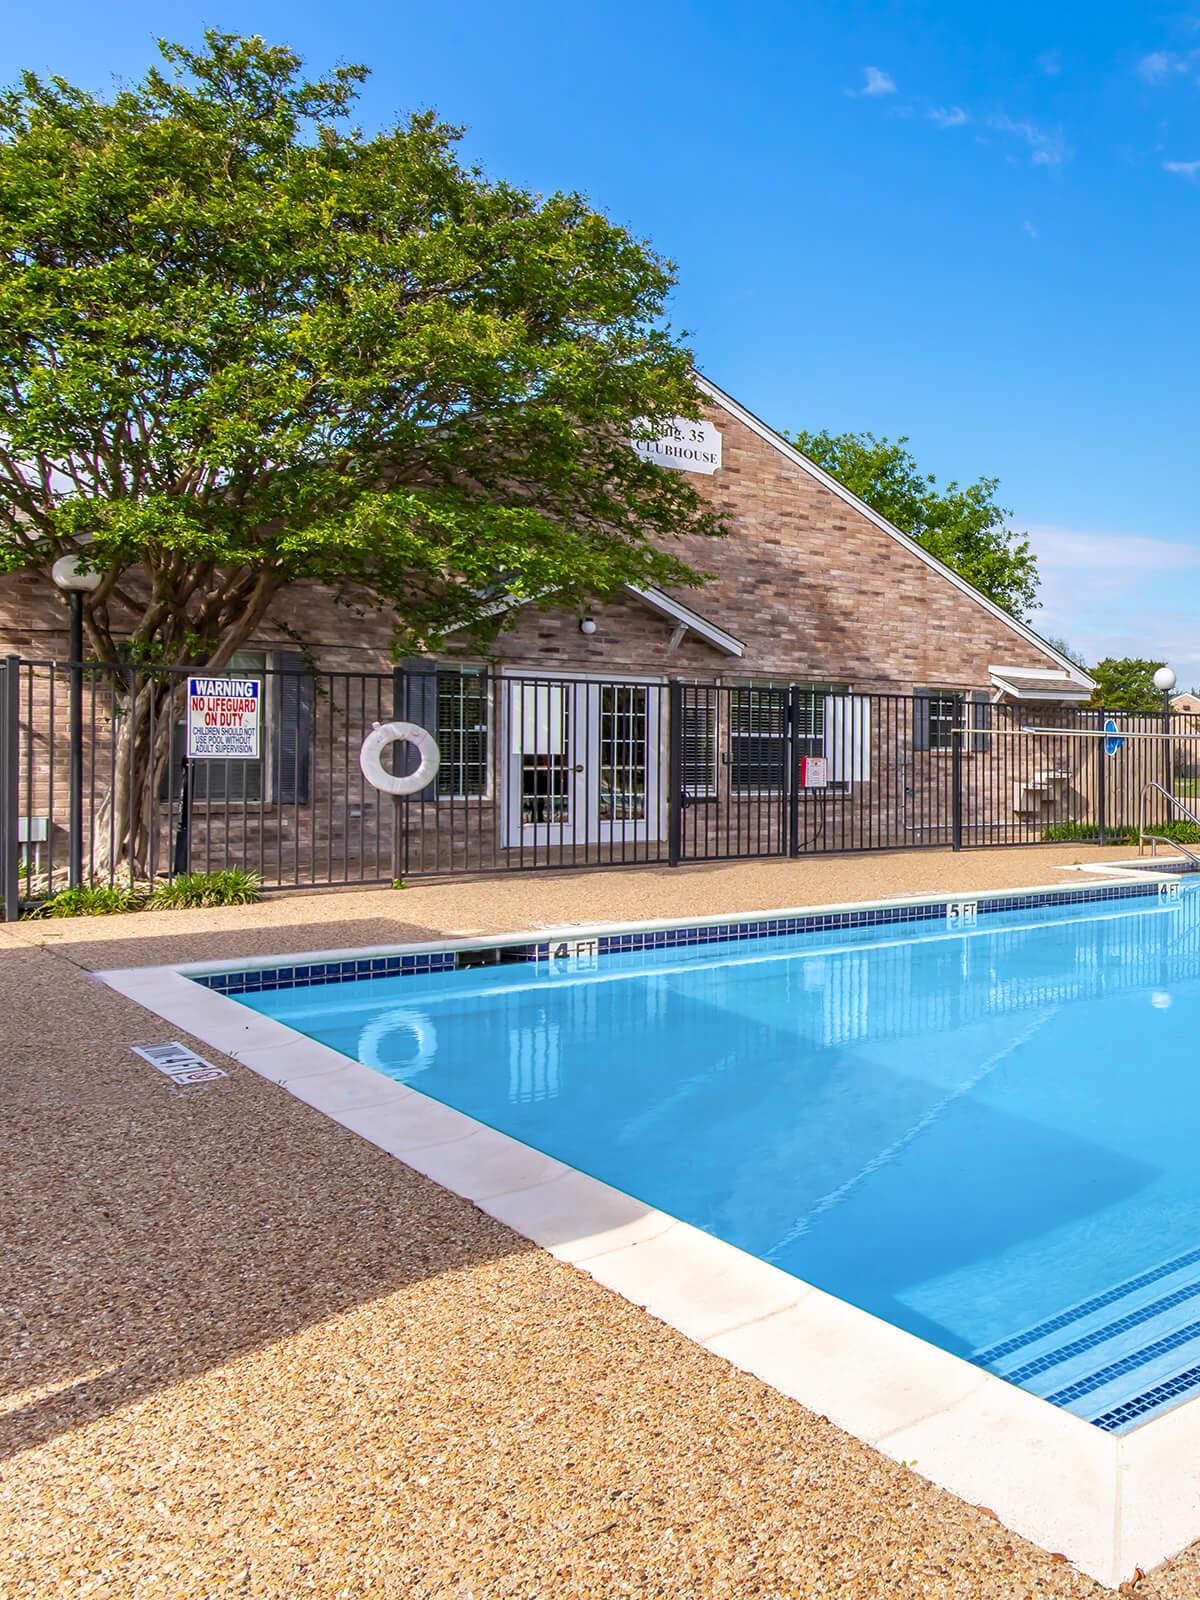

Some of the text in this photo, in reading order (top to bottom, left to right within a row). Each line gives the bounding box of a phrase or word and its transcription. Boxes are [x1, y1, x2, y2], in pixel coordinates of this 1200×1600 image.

[688, 429, 705, 443] 35
[636, 440, 718, 465] CLUBHOUSE
[195, 680, 254, 697] WARNING
[192, 697, 256, 713] NO LIFEGUARD
[204, 711, 243, 727] ON DUTY
[192, 726, 255, 737] CHILDREN SHOULD NOT
[195, 735, 251, 745] USE POOL WITHOUT
[195, 744, 253, 753] ADULT SUPERVISION
[1160, 883, 1179, 895] 4 FT
[949, 903, 976, 918] 5 FT
[553, 940, 596, 960] 4 FT
